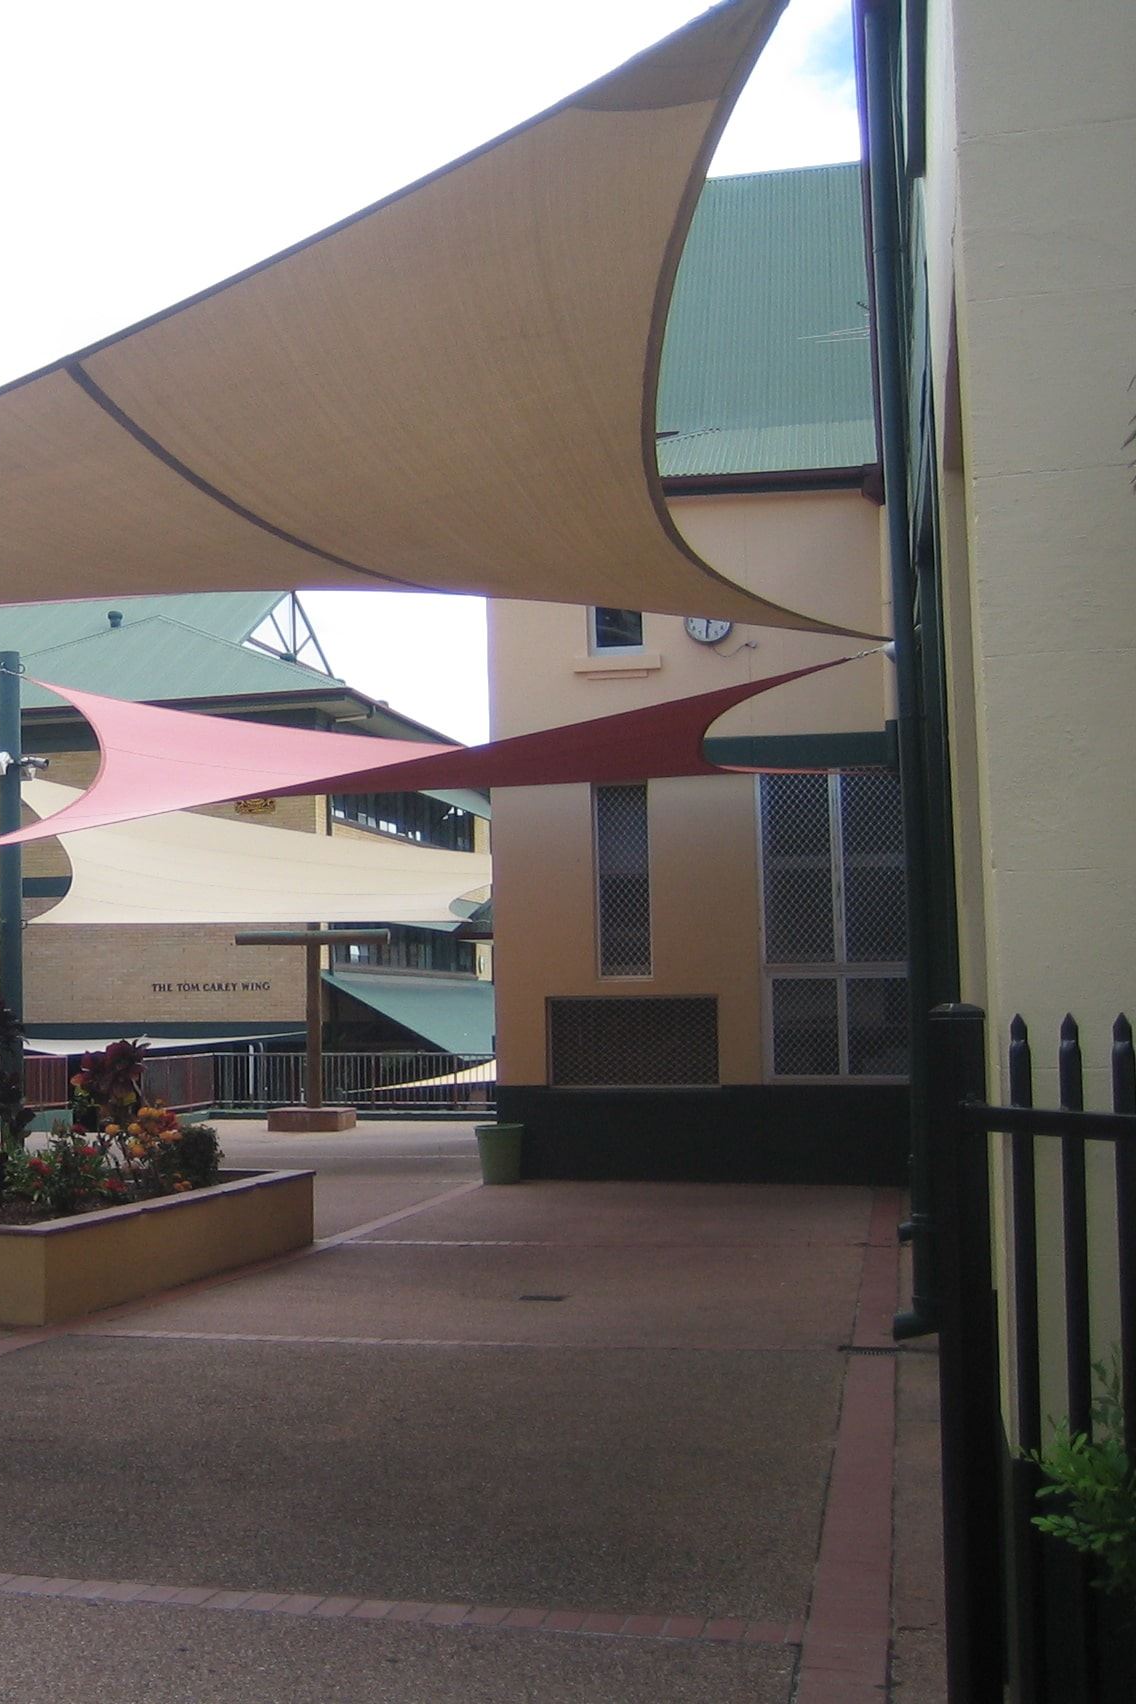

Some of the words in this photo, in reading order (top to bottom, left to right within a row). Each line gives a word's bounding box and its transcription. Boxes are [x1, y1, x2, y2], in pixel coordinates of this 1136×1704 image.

[152, 983, 173, 992] THE
[177, 983, 200, 992] TOM
[203, 983, 238, 992] CAREY
[241, 982, 270, 991] WING
